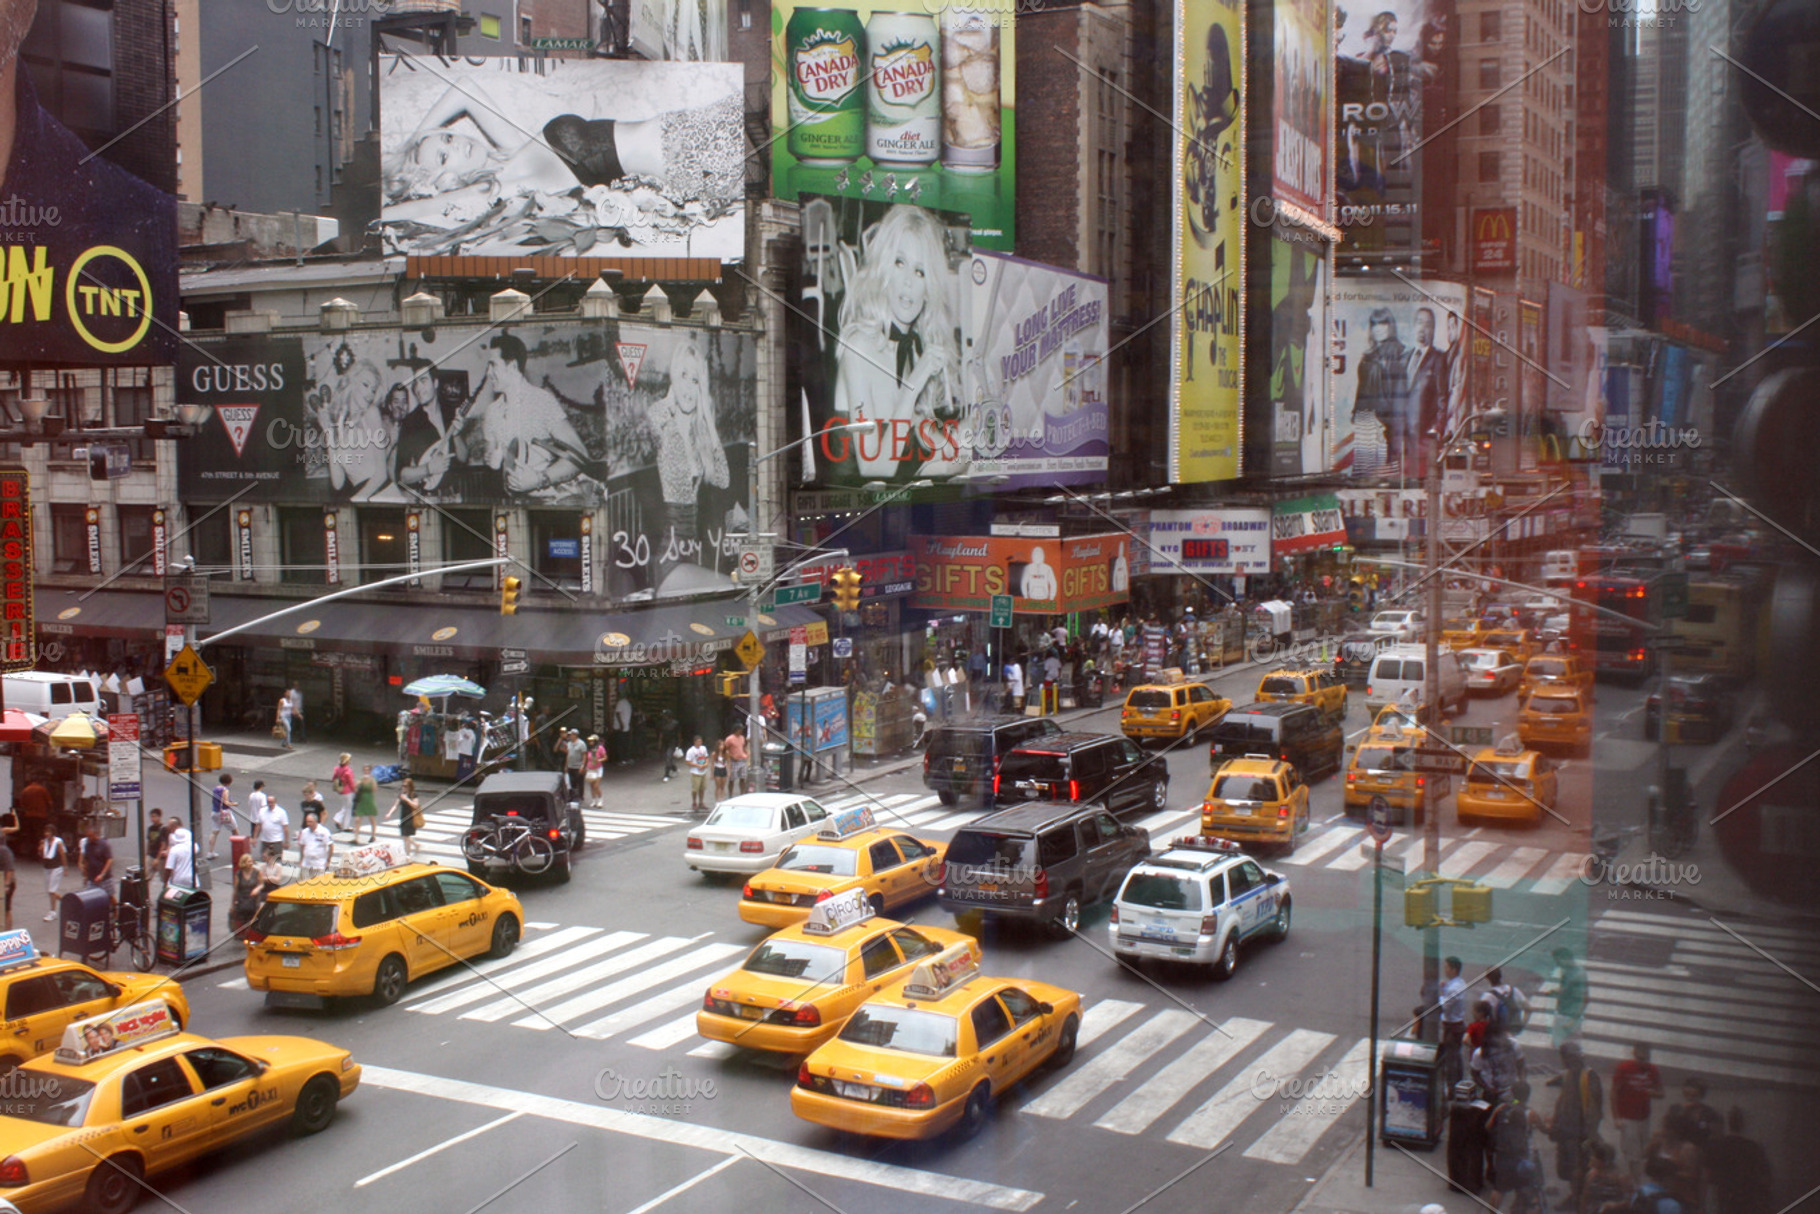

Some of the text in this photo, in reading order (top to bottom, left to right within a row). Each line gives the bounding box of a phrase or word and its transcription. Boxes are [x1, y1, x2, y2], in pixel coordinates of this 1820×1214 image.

[536, 40, 589, 50] LAMAR
[796, 52, 859, 84] CANADA
[873, 60, 936, 89] CANADA
[814, 71, 848, 93] DRY
[892, 77, 925, 98] DRY
[1342, 101, 1422, 121] ROW
[801, 134, 841, 144] GINGER
[877, 138, 936, 149] GINGER ALE
[900, 131, 921, 141] diet
[78, 285, 140, 317] TNT
[1015, 283, 1076, 347] LONG LIVE
[621, 345, 642, 358] GUESS
[1002, 343, 1036, 380] YOUR
[192, 363, 285, 392] GUESS
[223, 408, 252, 421] GUESS
[821, 416, 960, 462] GUESS
[1150, 521, 1267, 531] PHANTOM BROADWAY
[613, 531, 650, 567] 30
[660, 525, 703, 566] Sexy
[928, 542, 988, 558] Playland
[1184, 540, 1228, 557] GIFTS
[2, 480, 27, 660] BRASSERIE
[857, 555, 915, 581] GIFTS
[884, 582, 912, 593] LUGGAGE
[916, 563, 1004, 596] GIFTS
[1062, 564, 1107, 598] GIFTS
[789, 590, 794, 600] 7
[1435, 756, 1457, 766] WAY
